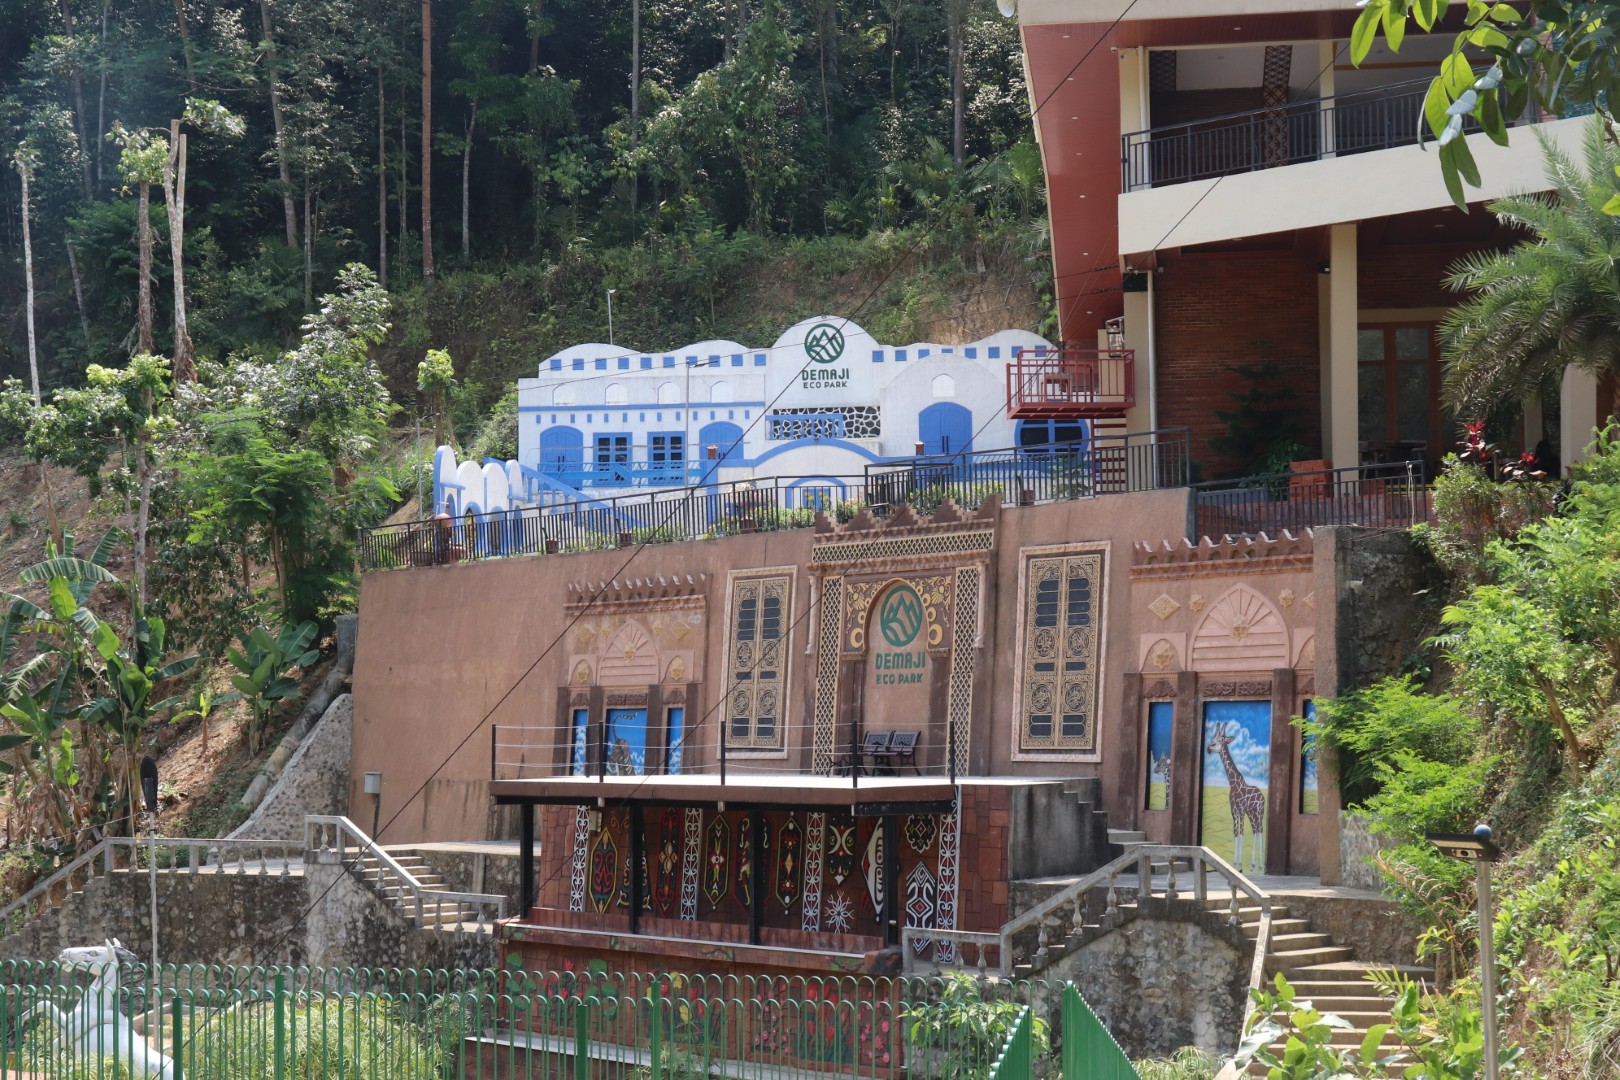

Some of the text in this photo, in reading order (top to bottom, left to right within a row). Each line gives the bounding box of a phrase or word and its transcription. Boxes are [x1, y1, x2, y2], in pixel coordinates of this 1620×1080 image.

[802, 368, 849, 380] DEMAJI
[875, 652, 926, 670] DEMAJI
[876, 673, 923, 684] ECO PARK
